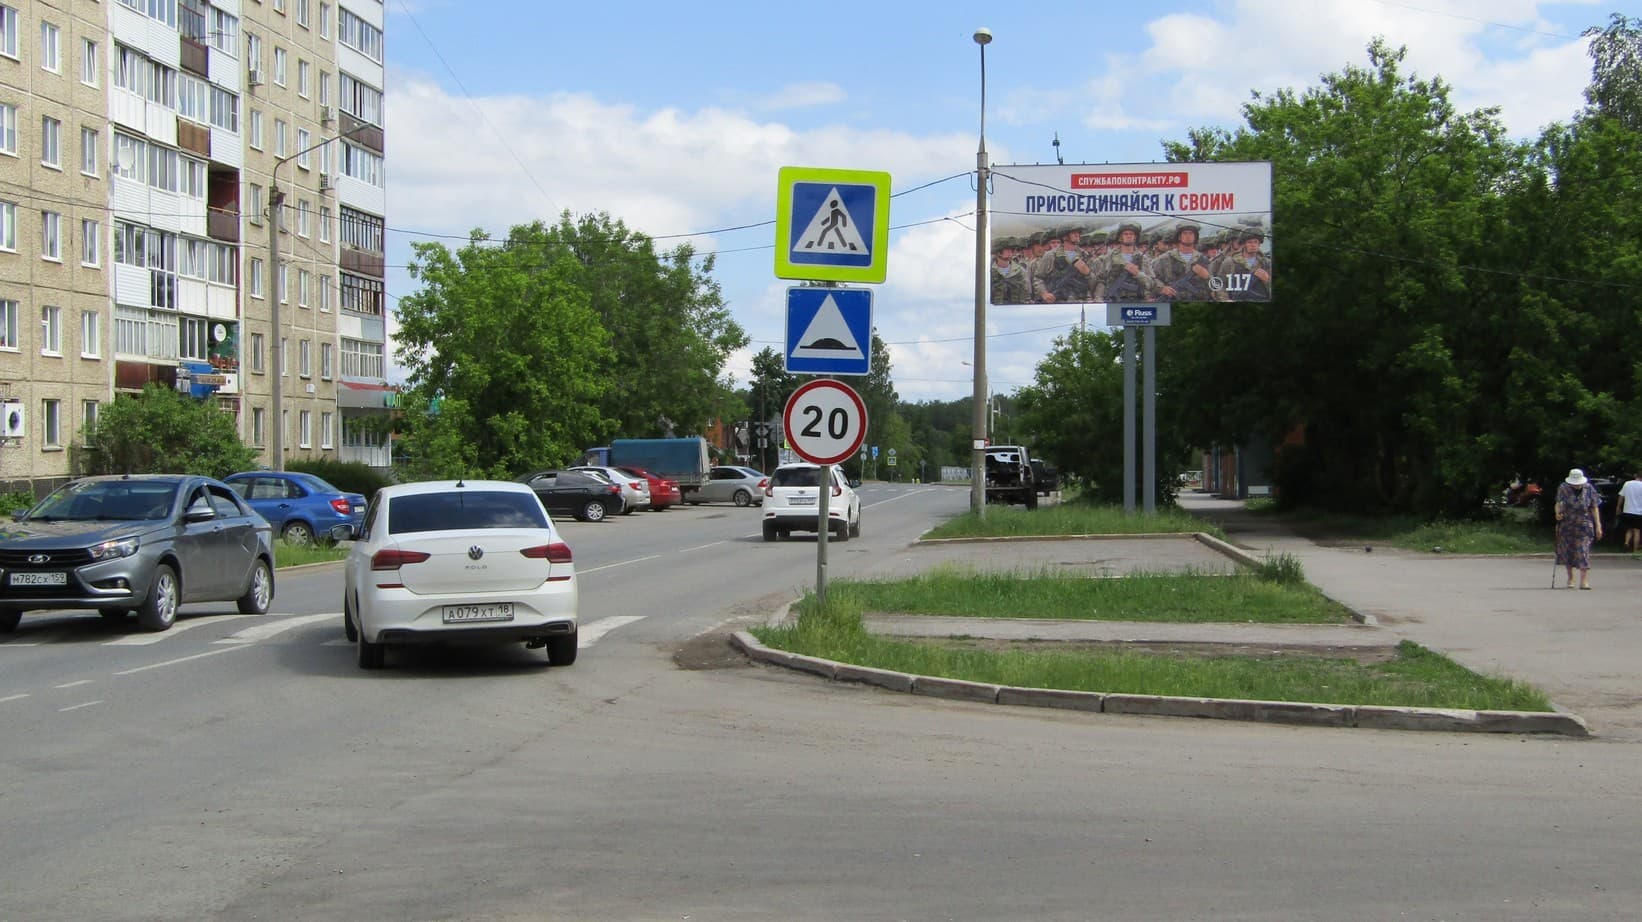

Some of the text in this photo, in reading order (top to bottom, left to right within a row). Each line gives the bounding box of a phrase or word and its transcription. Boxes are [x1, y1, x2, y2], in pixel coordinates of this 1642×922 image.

[1078, 175, 1181, 186] СЛУЖБАПОКОНТРАКТУ.РФ
[1026, 190, 1234, 213] ПРИСОЕДИНЯЙСЯ К СВОИМ
[1226, 273, 1251, 291] 117
[801, 405, 849, 440] 20
